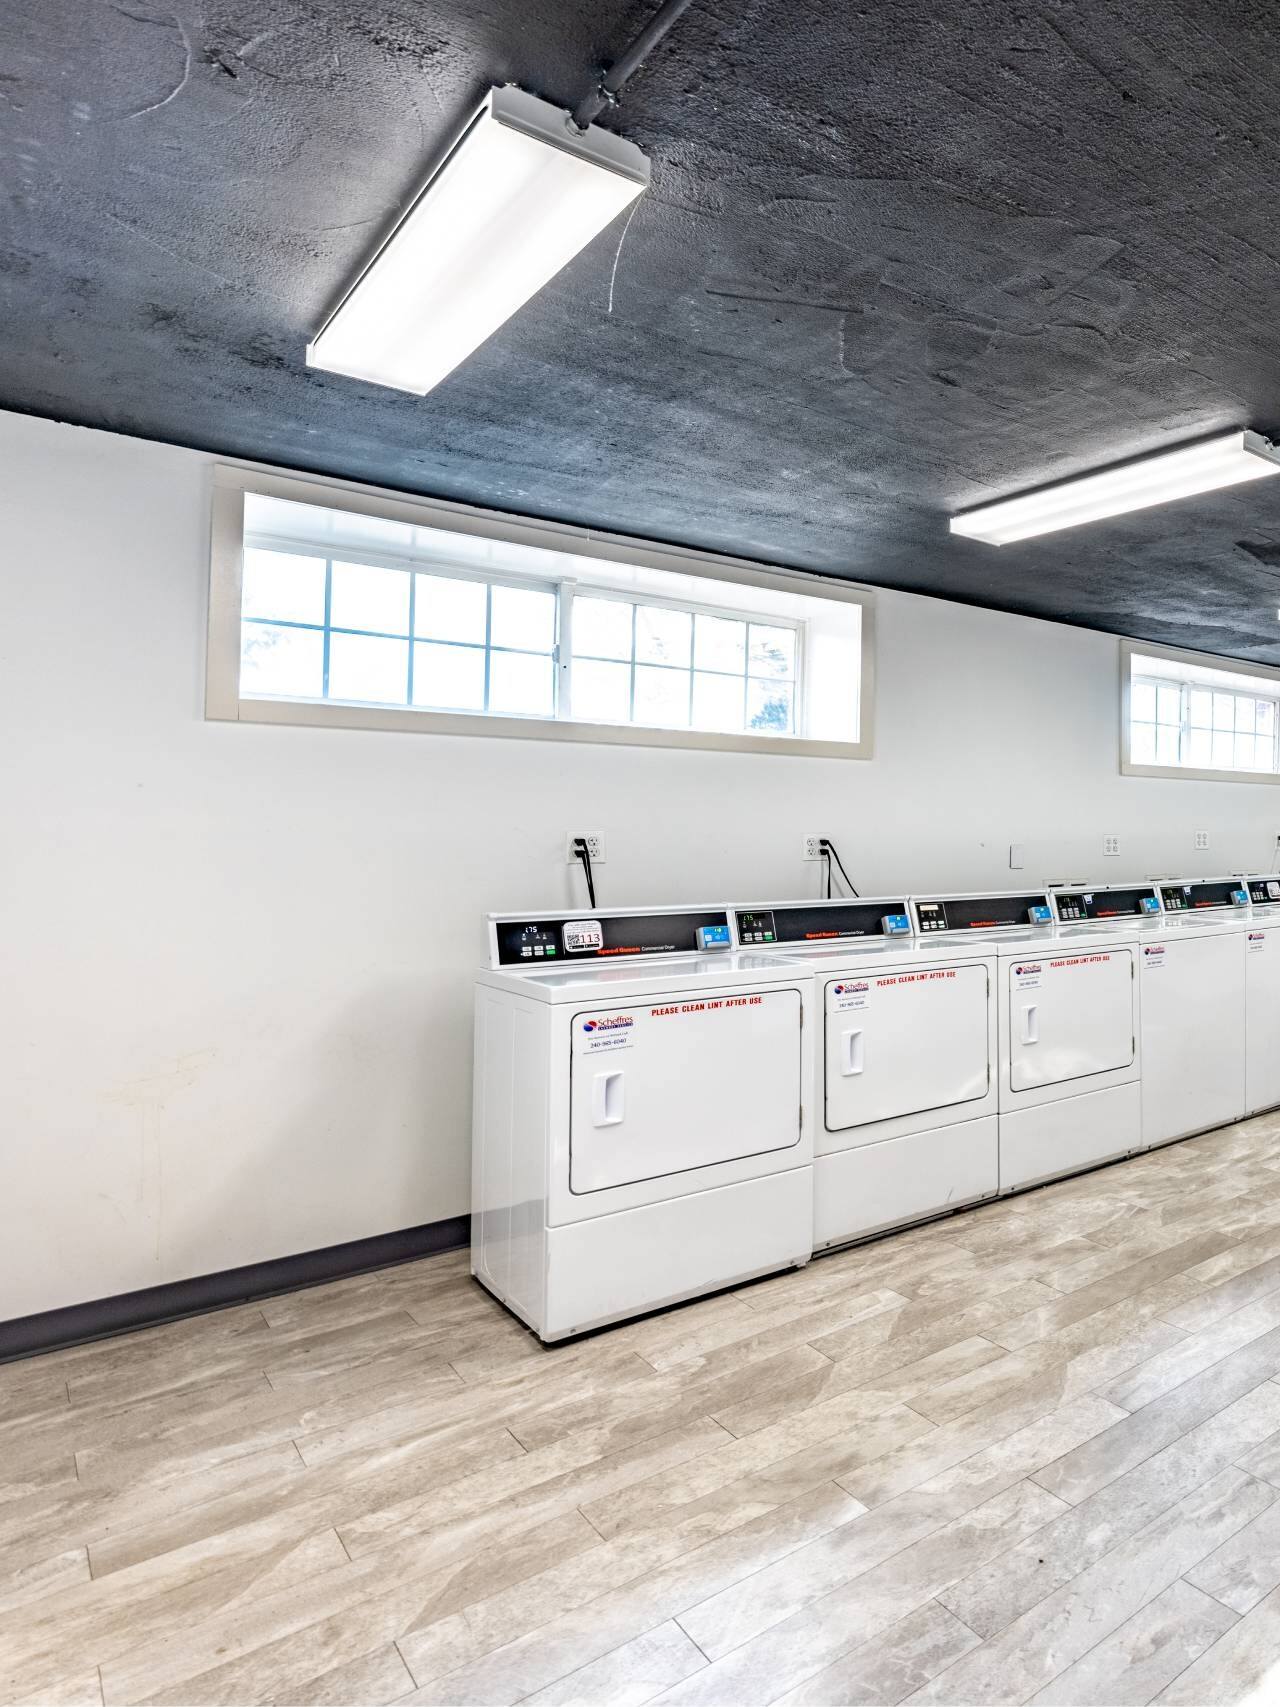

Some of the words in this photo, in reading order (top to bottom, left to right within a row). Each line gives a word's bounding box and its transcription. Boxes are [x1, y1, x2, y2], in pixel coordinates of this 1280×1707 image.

[579, 933, 601, 944] 113
[597, 947, 619, 955] Speed
[877, 977, 897, 987] PLEASE
[898, 975, 915, 984] CLEAN
[929, 972, 945, 980] AFTER
[651, 1007, 679, 1017] PLEASE
[682, 1003, 705, 1013] CLEAN
[707, 1001, 722, 1010] LINT
[725, 998, 747, 1007] AFTER
[749, 996, 762, 1004] USE
[598, 1015, 633, 1027] Scheffres
